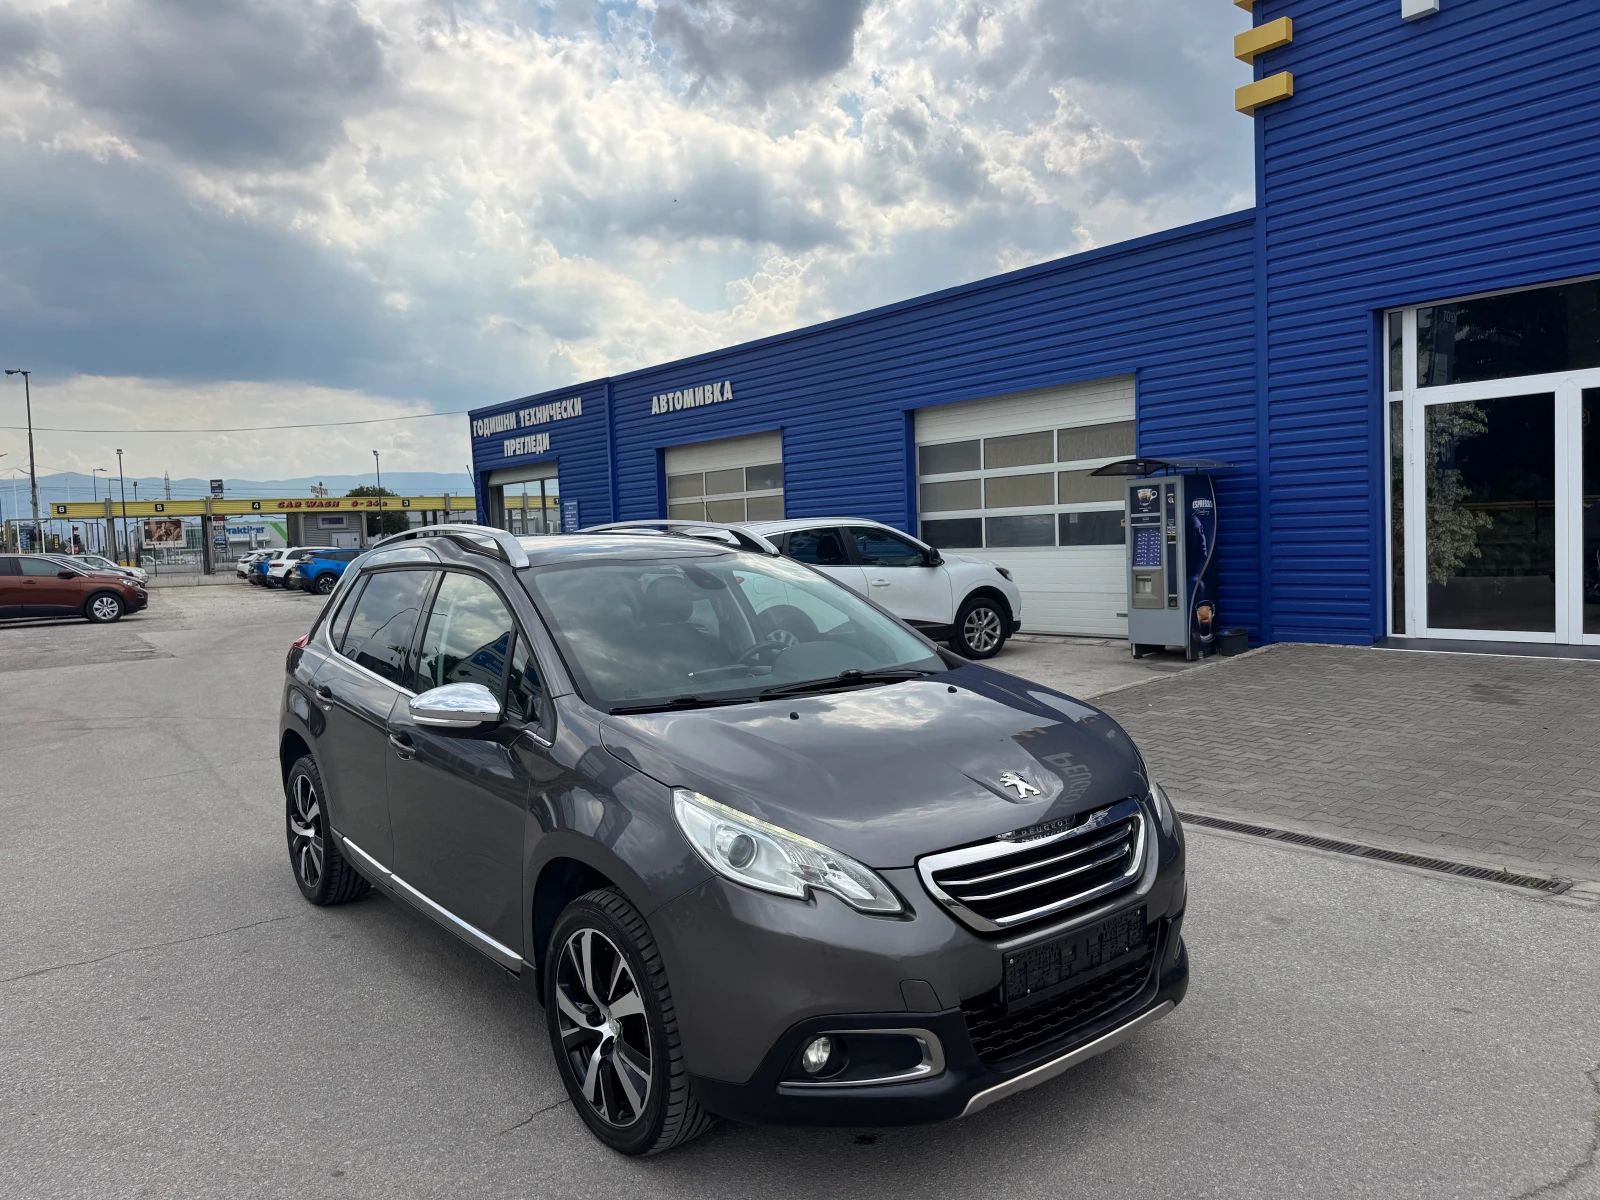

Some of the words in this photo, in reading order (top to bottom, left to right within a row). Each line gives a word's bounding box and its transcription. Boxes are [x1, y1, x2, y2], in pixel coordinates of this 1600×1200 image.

[651, 380, 733, 415] АВТОМИВКА
[473, 411, 517, 437] ГОДИШНИ
[519, 397, 583, 428] ТЕХНИЧЕСКИ
[504, 432, 550, 457] ПРЕГЛЕДИ
[305, 500, 340, 508] WASH
[1021, 819, 1069, 836] PEUGEOT
